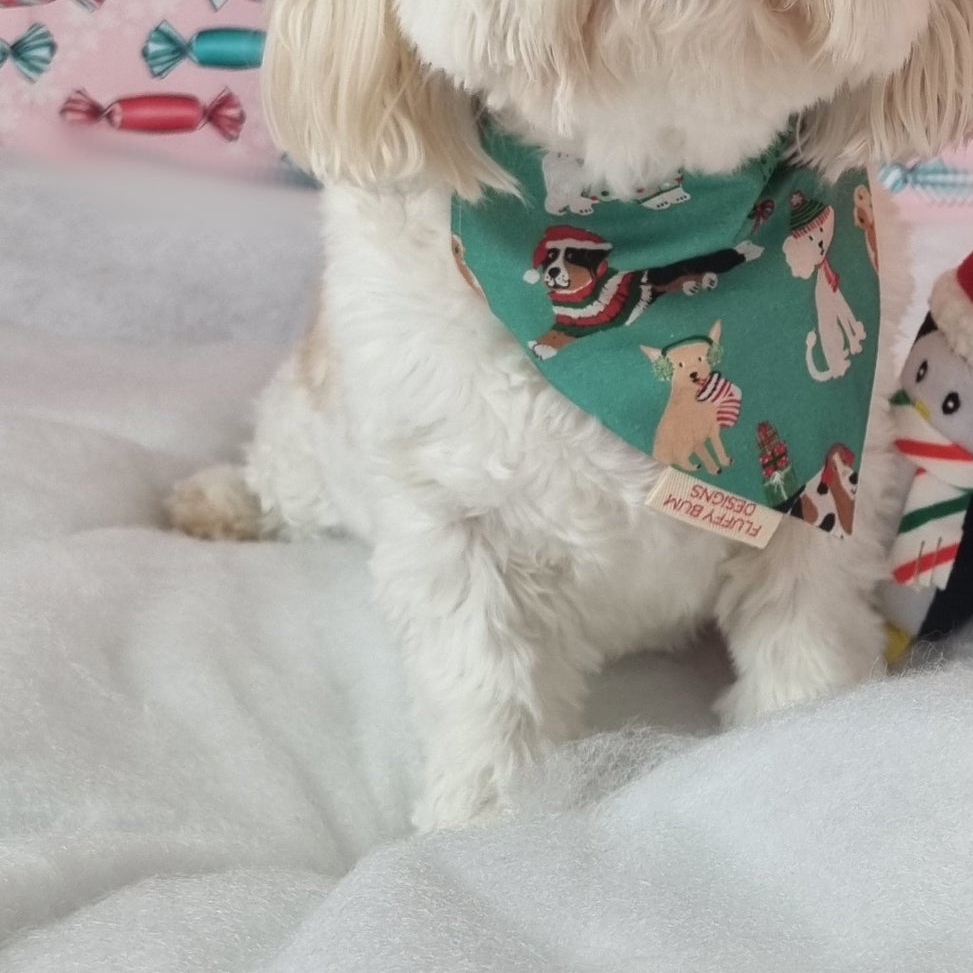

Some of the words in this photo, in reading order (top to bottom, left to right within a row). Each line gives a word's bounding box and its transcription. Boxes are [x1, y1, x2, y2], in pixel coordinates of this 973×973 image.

[663, 493, 704, 518] BUM
[690, 484, 757, 516] DESIGNS
[702, 510, 763, 538] FLUFFY
